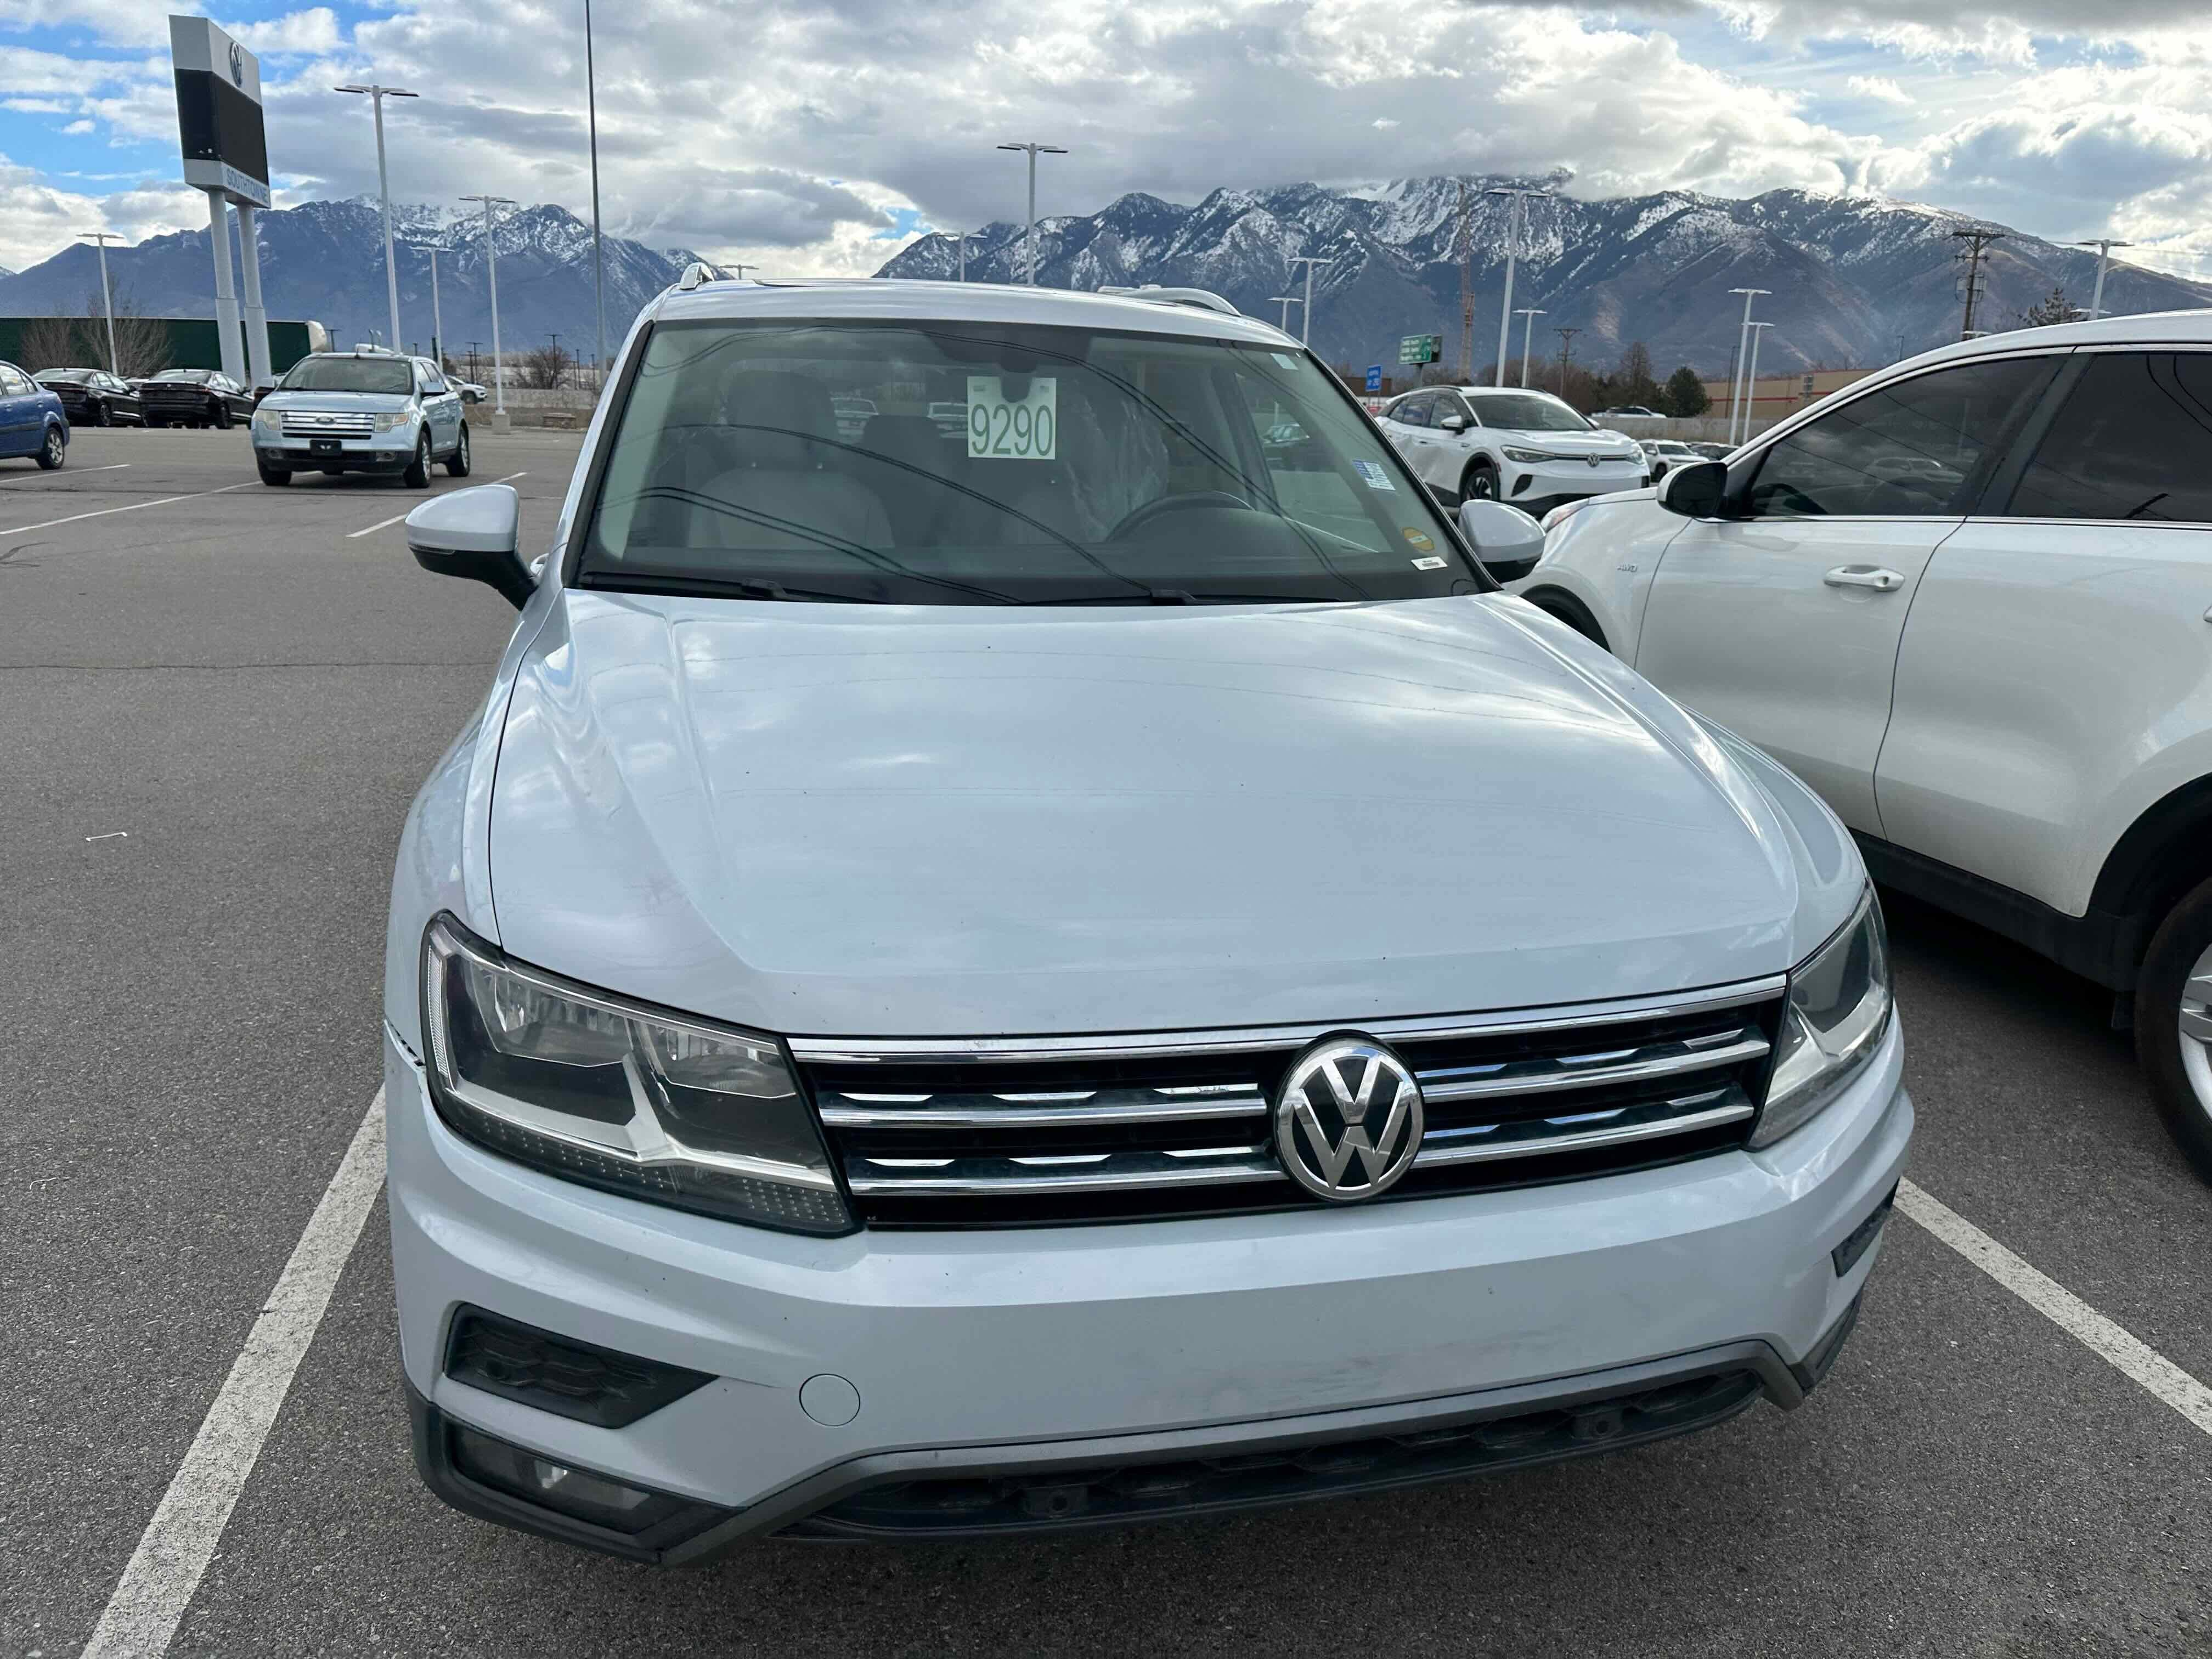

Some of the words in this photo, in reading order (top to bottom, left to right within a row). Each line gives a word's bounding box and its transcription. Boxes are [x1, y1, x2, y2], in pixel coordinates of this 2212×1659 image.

[227, 168, 267, 203] SOUTHTOWNE
[971, 404, 1053, 456] 9290
[1616, 562, 1638, 572] AWD
[1281, 1041, 1419, 1197] VW
